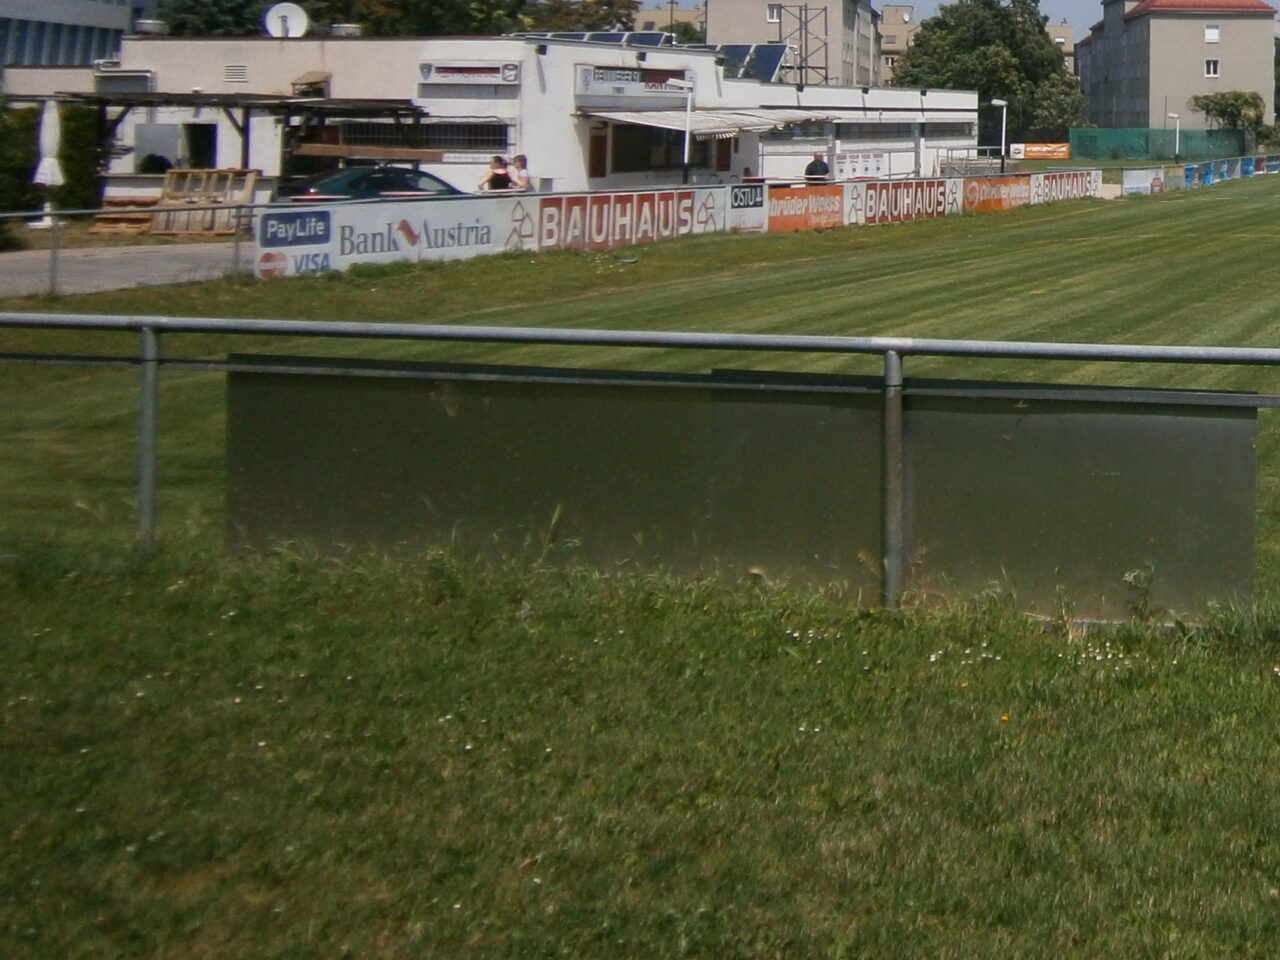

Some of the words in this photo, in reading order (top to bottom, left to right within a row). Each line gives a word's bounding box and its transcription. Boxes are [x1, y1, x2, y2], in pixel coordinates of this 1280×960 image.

[867, 186, 945, 217] BAUHAUS
[1044, 175, 1091, 201] BAUHAUS
[266, 217, 325, 242] PayLife
[541, 198, 693, 247] BAUHAUS
[339, 222, 401, 256] Bank
[422, 218, 492, 249] Austria
[292, 252, 330, 274] VISA
